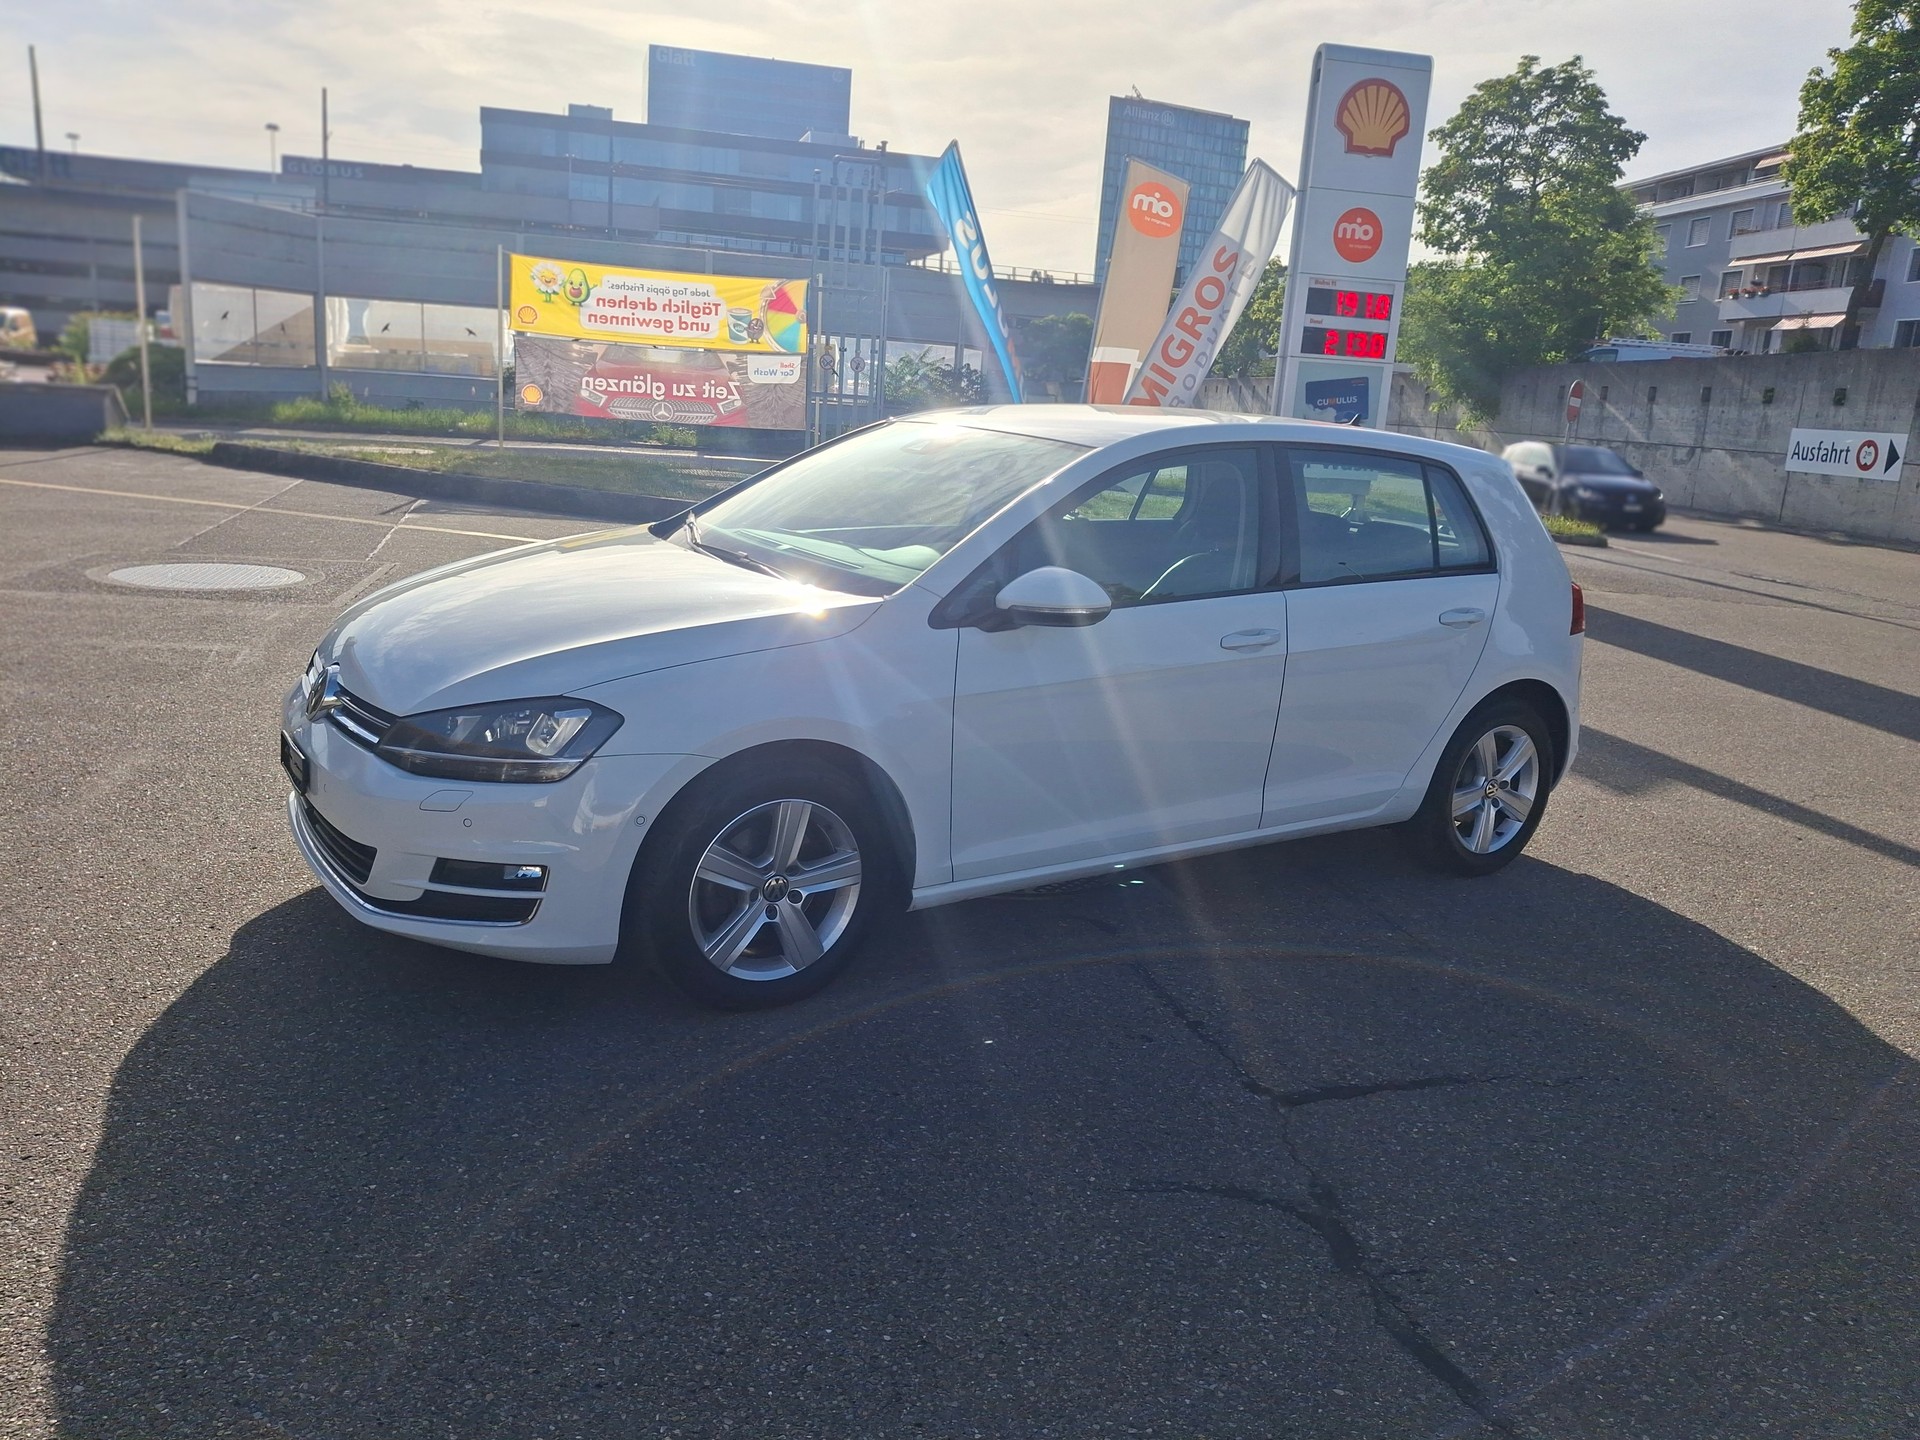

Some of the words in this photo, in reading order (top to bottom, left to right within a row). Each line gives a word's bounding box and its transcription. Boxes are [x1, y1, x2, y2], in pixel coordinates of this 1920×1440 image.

[656, 47, 696, 67] Glatt
[1123, 105, 1160, 120] Allianz
[287, 161, 363, 179] GLOBUS
[1132, 191, 1173, 218] mio
[1337, 217, 1374, 241] mio
[1129, 245, 1239, 407] MIGROS
[1169, 260, 1257, 408] RODUKTE
[1790, 441, 1851, 465] Ausfahrt
